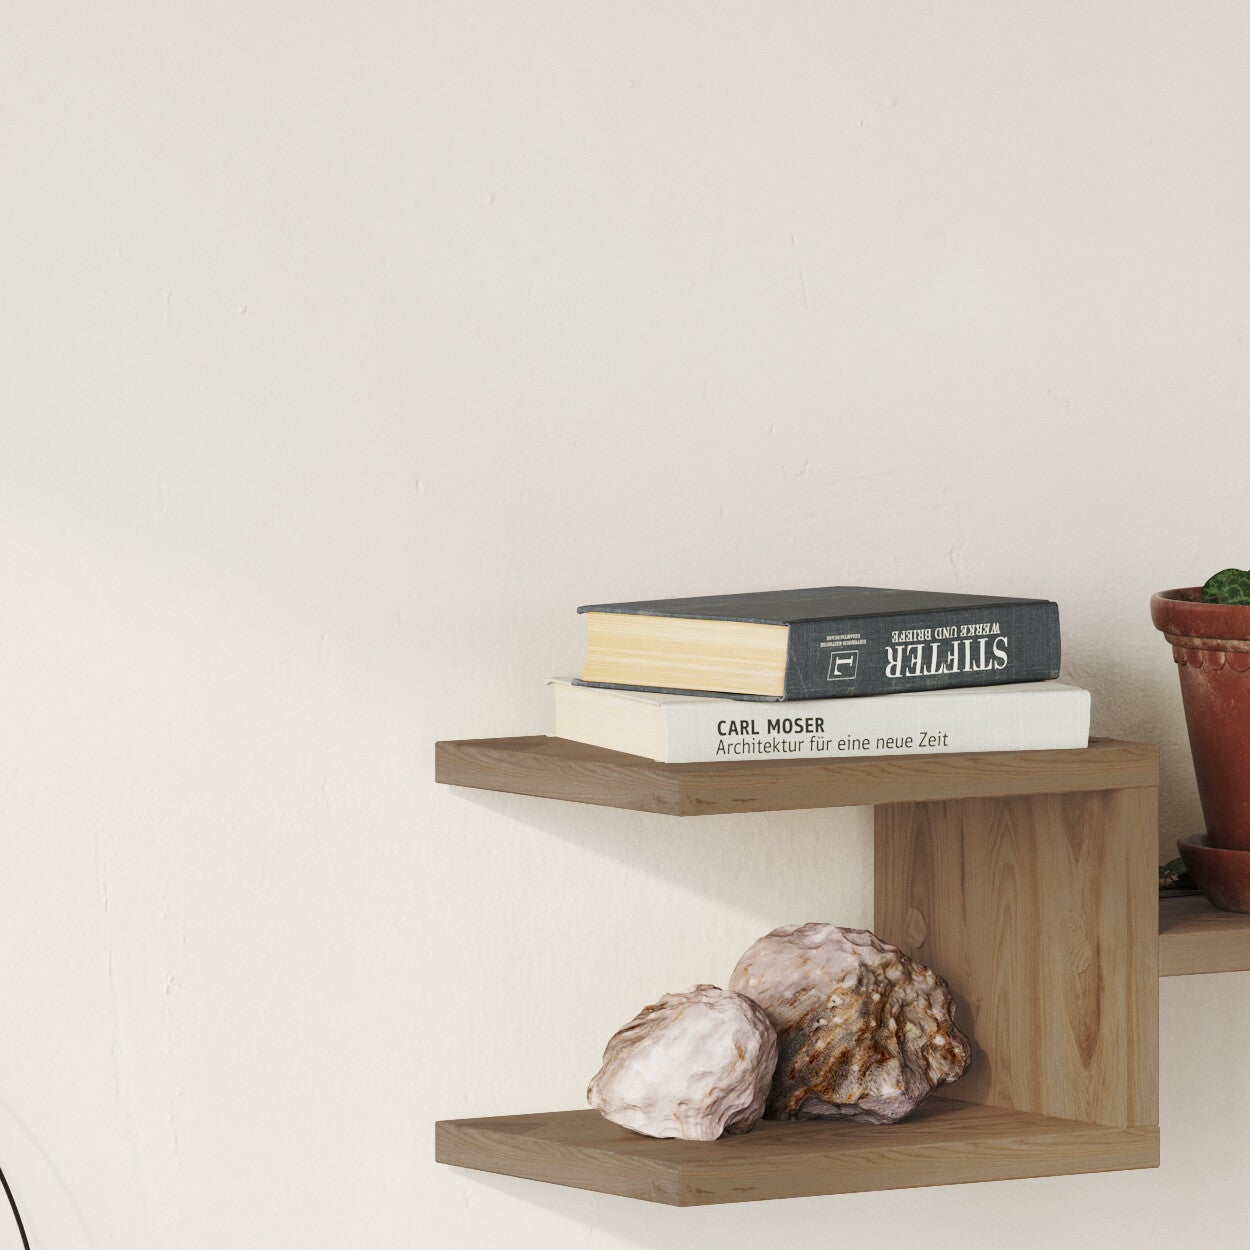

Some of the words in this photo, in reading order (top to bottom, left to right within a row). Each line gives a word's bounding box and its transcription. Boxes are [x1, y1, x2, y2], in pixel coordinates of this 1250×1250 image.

[891, 628, 932, 643] BRIEFE
[934, 626, 957, 639] UND
[960, 622, 1001, 637] WERKE
[885, 637, 1008, 678] STIFTER
[717, 719, 760, 736] CARL
[767, 717, 825, 735] MOSER
[715, 737, 805, 755] Architektur
[809, 735, 832, 752] für
[837, 735, 870, 751] eine
[876, 734, 913, 749] neue
[918, 732, 949, 748] Zeit
